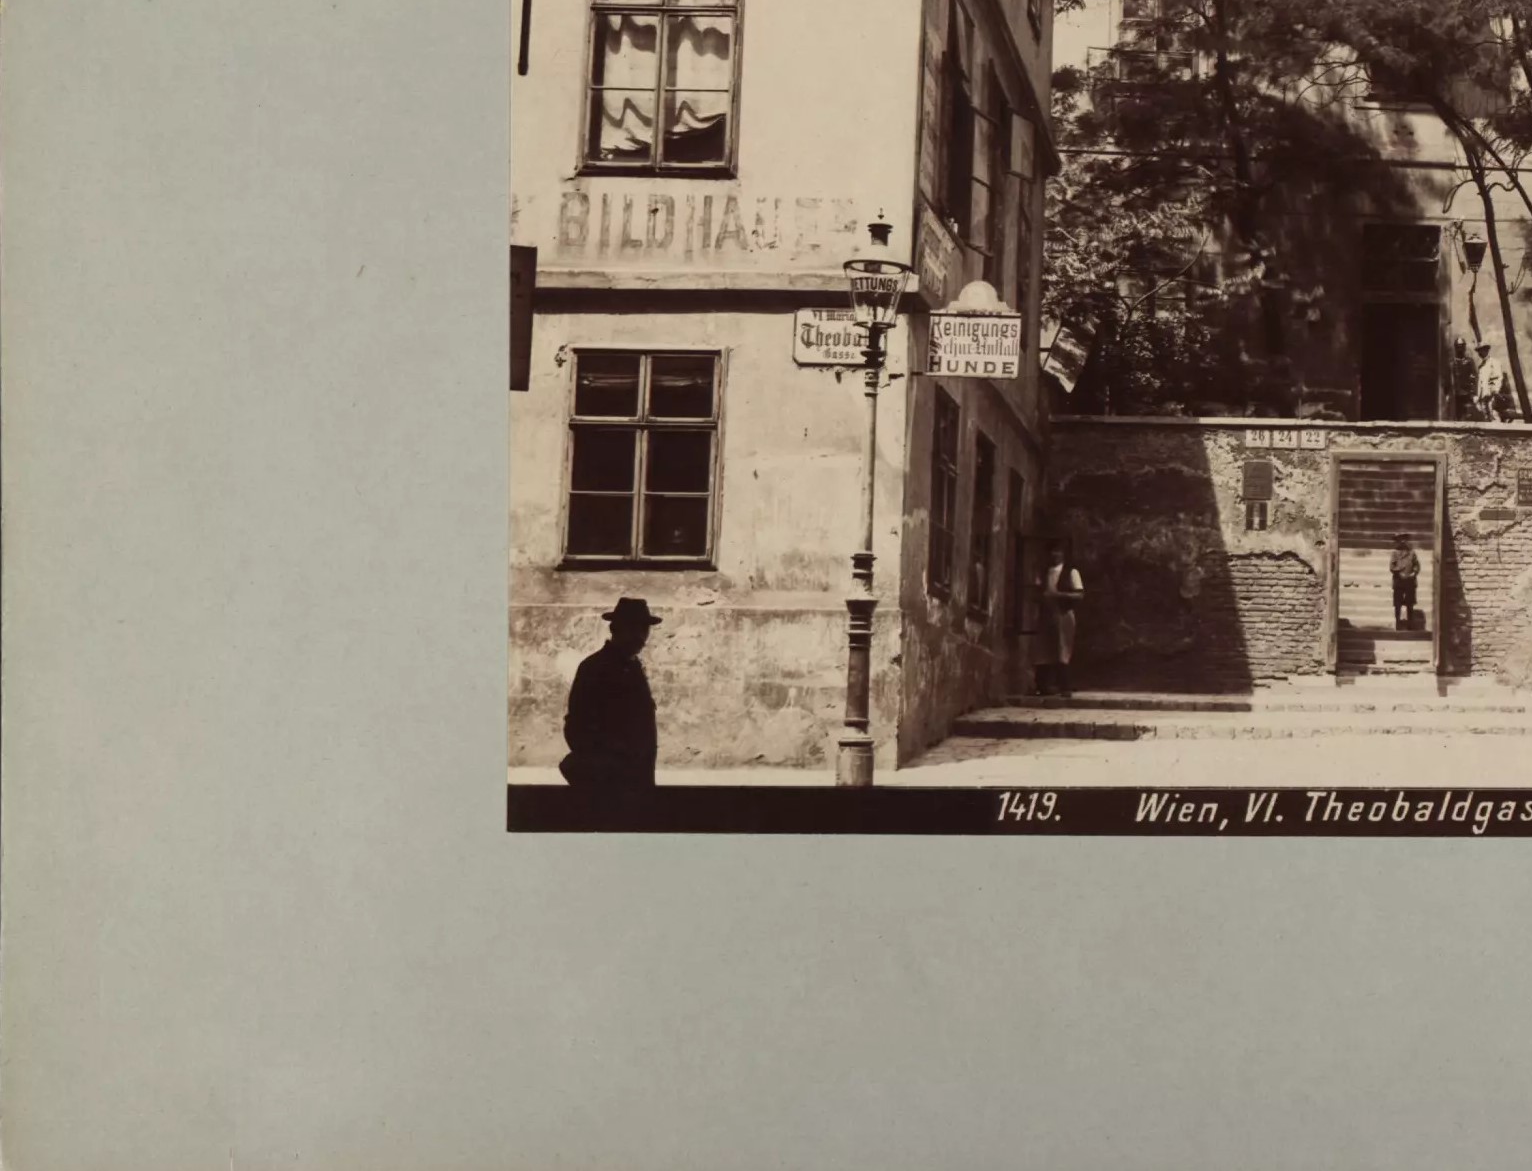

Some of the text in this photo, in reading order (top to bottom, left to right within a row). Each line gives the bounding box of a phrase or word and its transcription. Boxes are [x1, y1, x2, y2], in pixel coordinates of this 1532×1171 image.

[801, 322, 868, 349] Theoba
[931, 316, 1018, 342] Reinigungs
[929, 355, 1015, 375] HUNDE
[1250, 430, 1266, 443] 26
[1278, 430, 1292, 443] 24
[1305, 431, 1320, 443] 22
